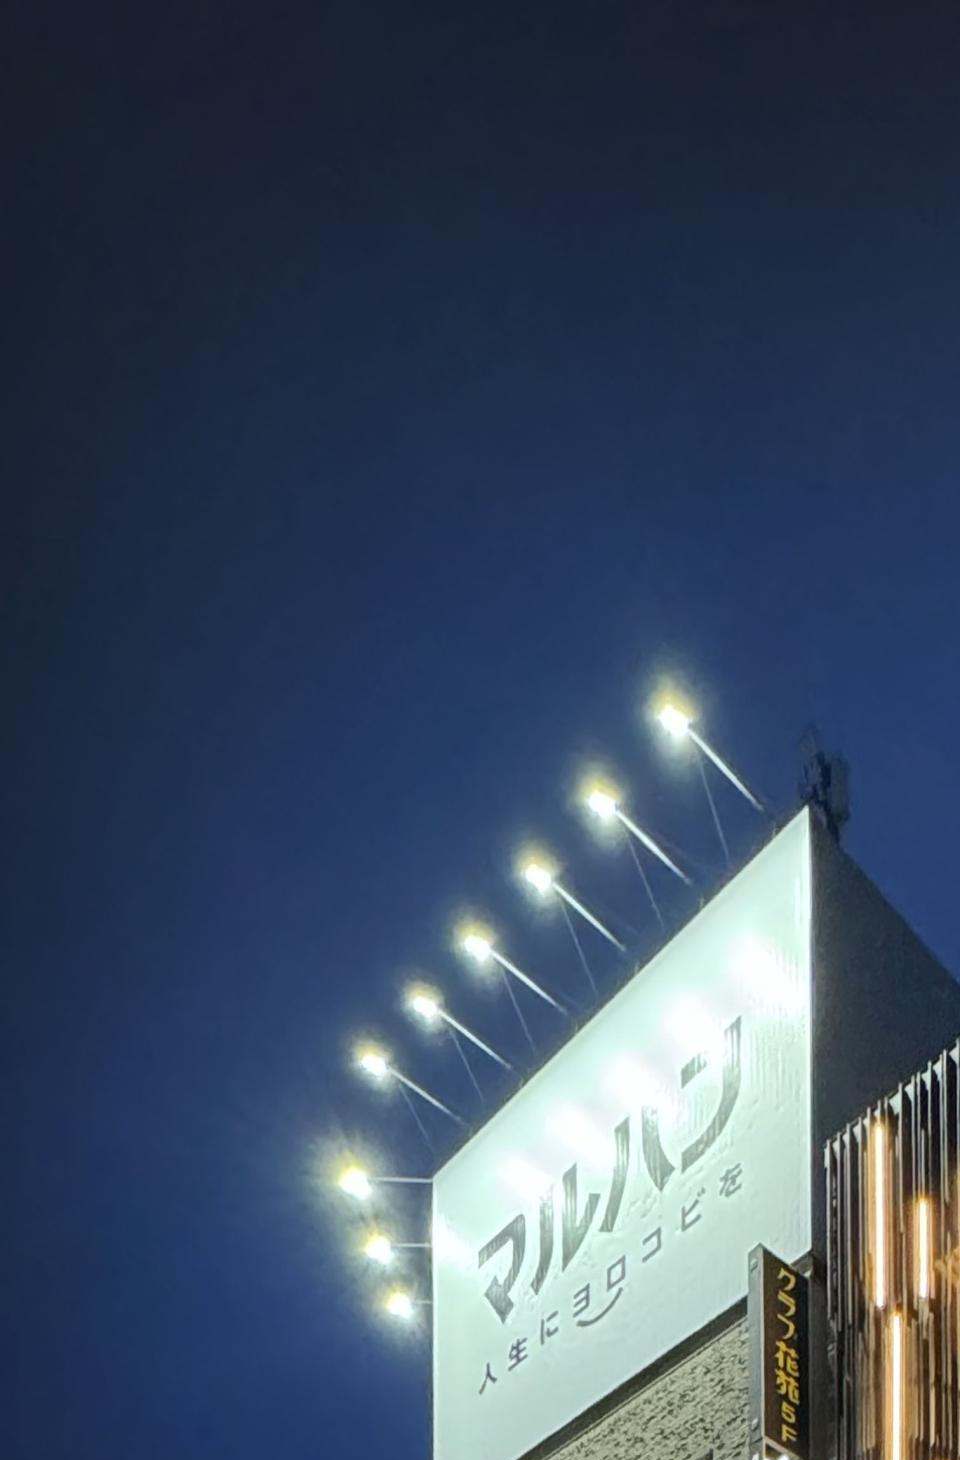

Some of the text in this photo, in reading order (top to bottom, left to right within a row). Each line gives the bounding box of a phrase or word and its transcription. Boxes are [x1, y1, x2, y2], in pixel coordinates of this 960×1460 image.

[478, 1015, 743, 1324] マルハン
[478, 1163, 744, 1395] 人生にヨロコビを
